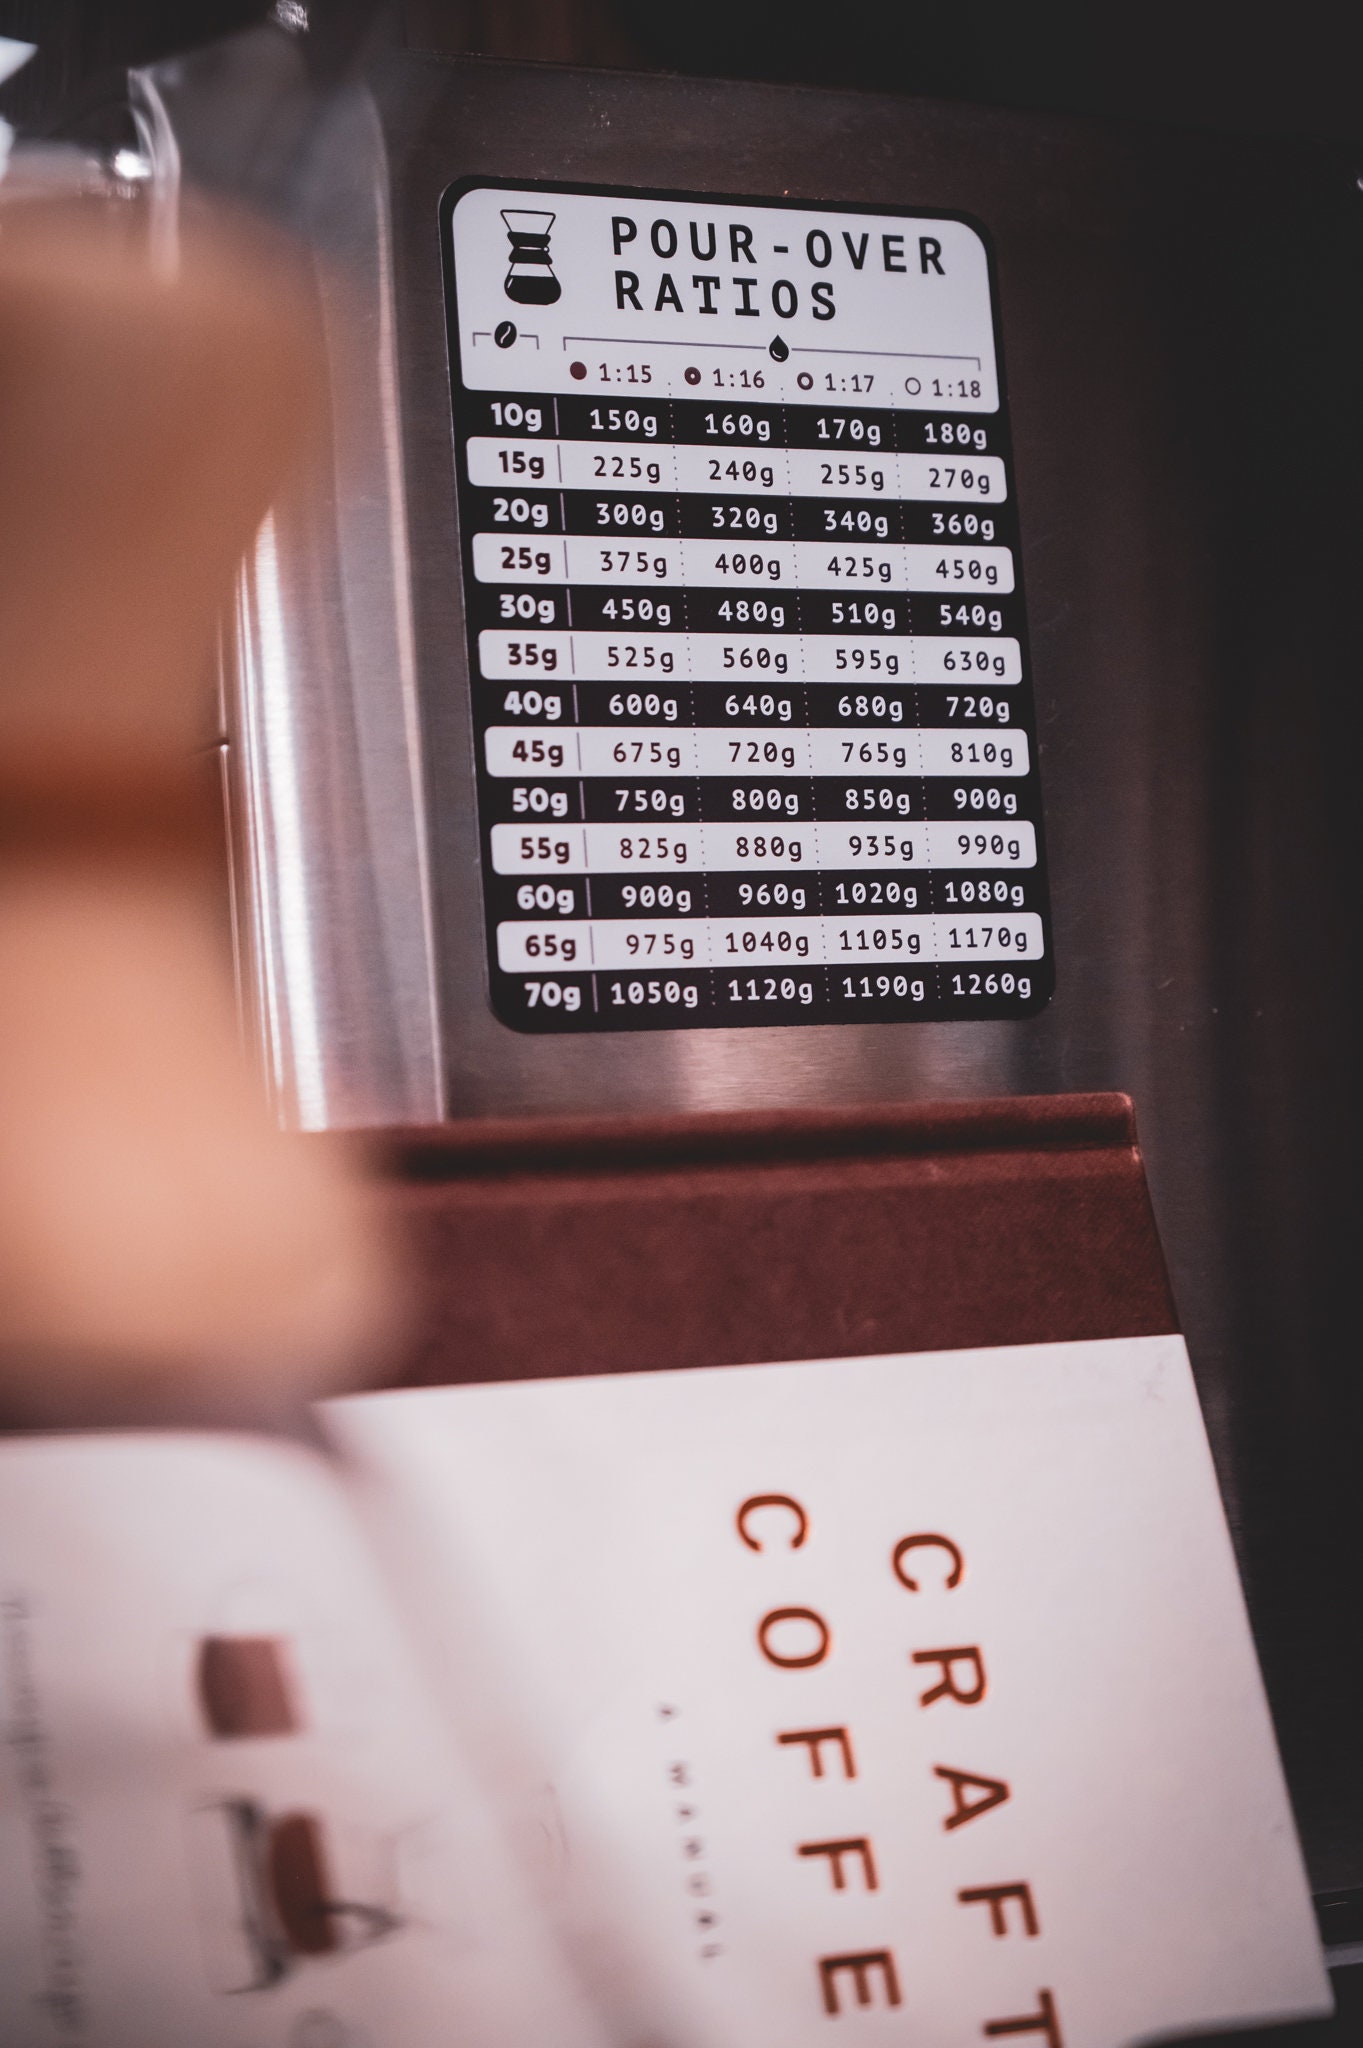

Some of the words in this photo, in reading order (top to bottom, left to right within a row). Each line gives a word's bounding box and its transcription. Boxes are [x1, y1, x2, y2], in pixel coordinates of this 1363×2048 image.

[611, 216, 946, 276] POUR-OVER
[614, 269, 836, 321] RATIOS
[598, 362, 652, 384] 1:15
[712, 368, 765, 389] 1:16
[824, 372, 875, 393] 1:17
[932, 378, 981, 399] 1:18
[490, 402, 542, 433] 10g
[590, 408, 658, 438] 150g
[704, 413, 771, 442] 160g
[816, 417, 881, 446] 170g
[924, 422, 987, 450] 180g
[498, 450, 545, 480] 15g
[593, 455, 661, 484] 225g
[708, 459, 774, 488] 240g
[820, 463, 884, 492] 255g
[928, 467, 990, 495] 270g
[493, 497, 549, 528] 20g
[596, 503, 664, 532] 300g
[711, 506, 778, 535] 320g
[823, 509, 889, 538] 340g
[931, 512, 995, 541] 360g
[501, 546, 551, 575] 25g
[600, 550, 667, 579] 375g
[714, 553, 781, 581] 400g
[827, 556, 892, 583] 425g
[935, 559, 998, 586] 450g
[499, 594, 555, 624] 30g
[602, 598, 671, 627] 450g
[717, 600, 785, 628] 480g
[832, 602, 896, 630] 510g
[940, 604, 1003, 632] 540g
[507, 643, 558, 672] 35g
[607, 646, 674, 674] 525g
[723, 647, 788, 675] 560g
[836, 648, 899, 676] 595g
[943, 650, 1006, 677] 630g
[503, 690, 562, 721] 40g
[609, 693, 678, 721] 600g
[725, 694, 792, 722] 640g
[838, 695, 903, 722] 680g
[946, 696, 1010, 723] 720g
[512, 739, 564, 768] 45g
[613, 742, 681, 769] 675g
[728, 741, 795, 769] 720g
[841, 742, 907, 769] 765g
[950, 742, 1013, 769] 810g
[512, 787, 568, 817] 50g
[615, 789, 685, 817] 750g
[732, 788, 799, 816] 800g
[845, 788, 911, 815] 850g
[953, 788, 1018, 815] 900g
[521, 836, 570, 865] 55g
[620, 837, 688, 864] 825g
[736, 836, 802, 863] 880g
[848, 835, 914, 862] 935g
[957, 834, 1020, 861] 990g
[517, 884, 575, 914] 60g
[621, 885, 692, 913] 900g
[738, 883, 806, 910] 960g
[835, 881, 918, 909] 1020g
[944, 880, 1025, 907] 1080g
[525, 934, 576, 962] 65g
[626, 933, 694, 960] 975g
[725, 930, 809, 957] 1040g
[839, 928, 921, 955] 1105g
[948, 926, 1028, 953] 1170g
[524, 981, 581, 1012] 70g
[610, 980, 698, 1009] 1050g
[728, 977, 813, 1005] 1120g
[842, 975, 925, 1002] 1190g
[952, 972, 1032, 999] 1260g
[891, 1532, 1065, 2048] CRAFT
